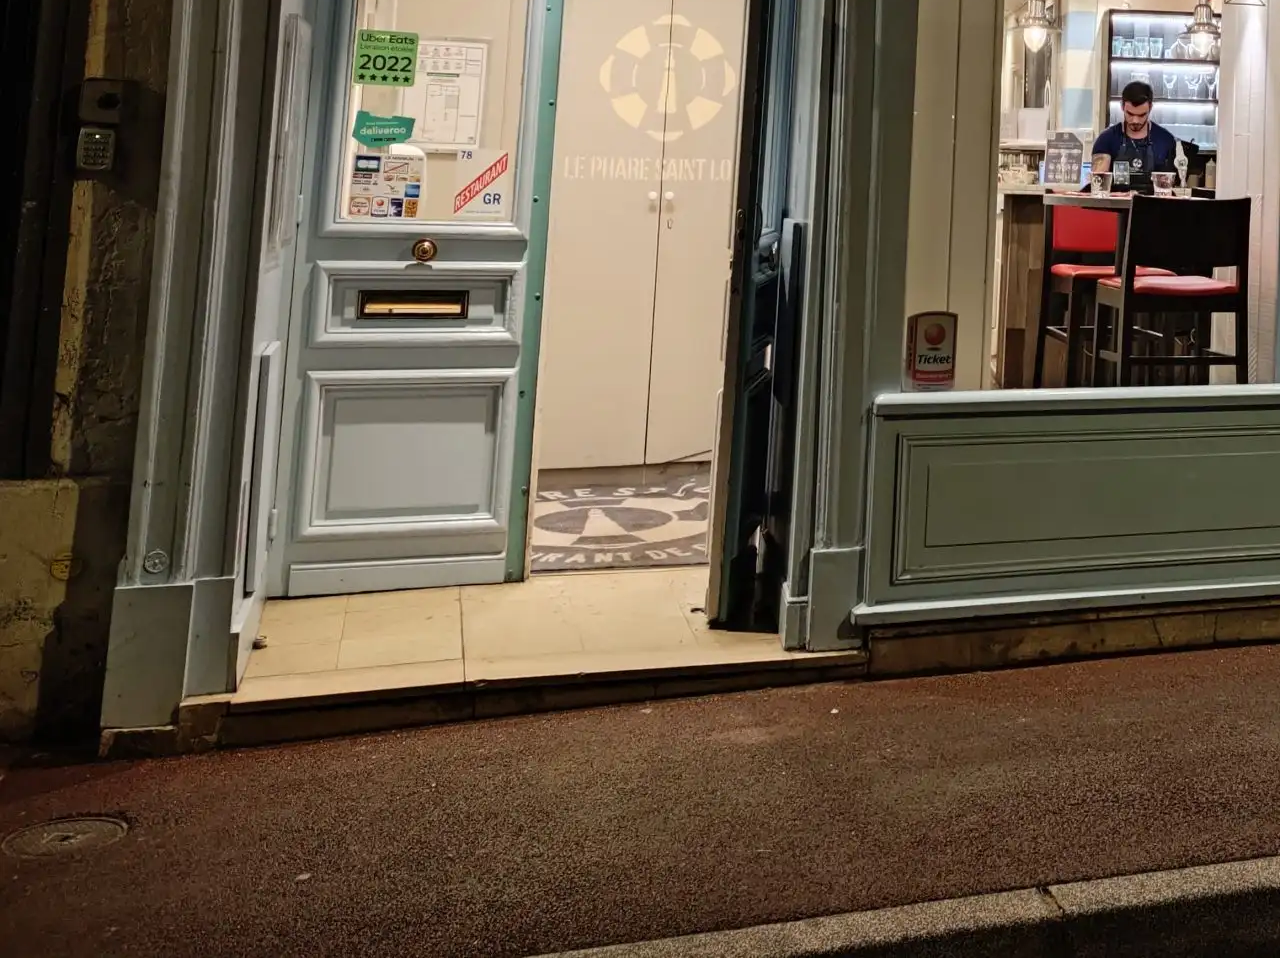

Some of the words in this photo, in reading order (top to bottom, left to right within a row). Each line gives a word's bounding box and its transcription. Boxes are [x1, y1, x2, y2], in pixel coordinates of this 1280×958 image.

[361, 32, 385, 43] Uber
[389, 34, 415, 45] Eats
[358, 53, 412, 72] 2022
[460, 150, 473, 160] 78
[563, 156, 586, 179] LE
[590, 157, 650, 181] PHARE
[655, 158, 707, 182] SAINT
[455, 153, 508, 212] RESTAURANT
[483, 192, 501, 205] GR
[918, 353, 952, 365] Ticket
